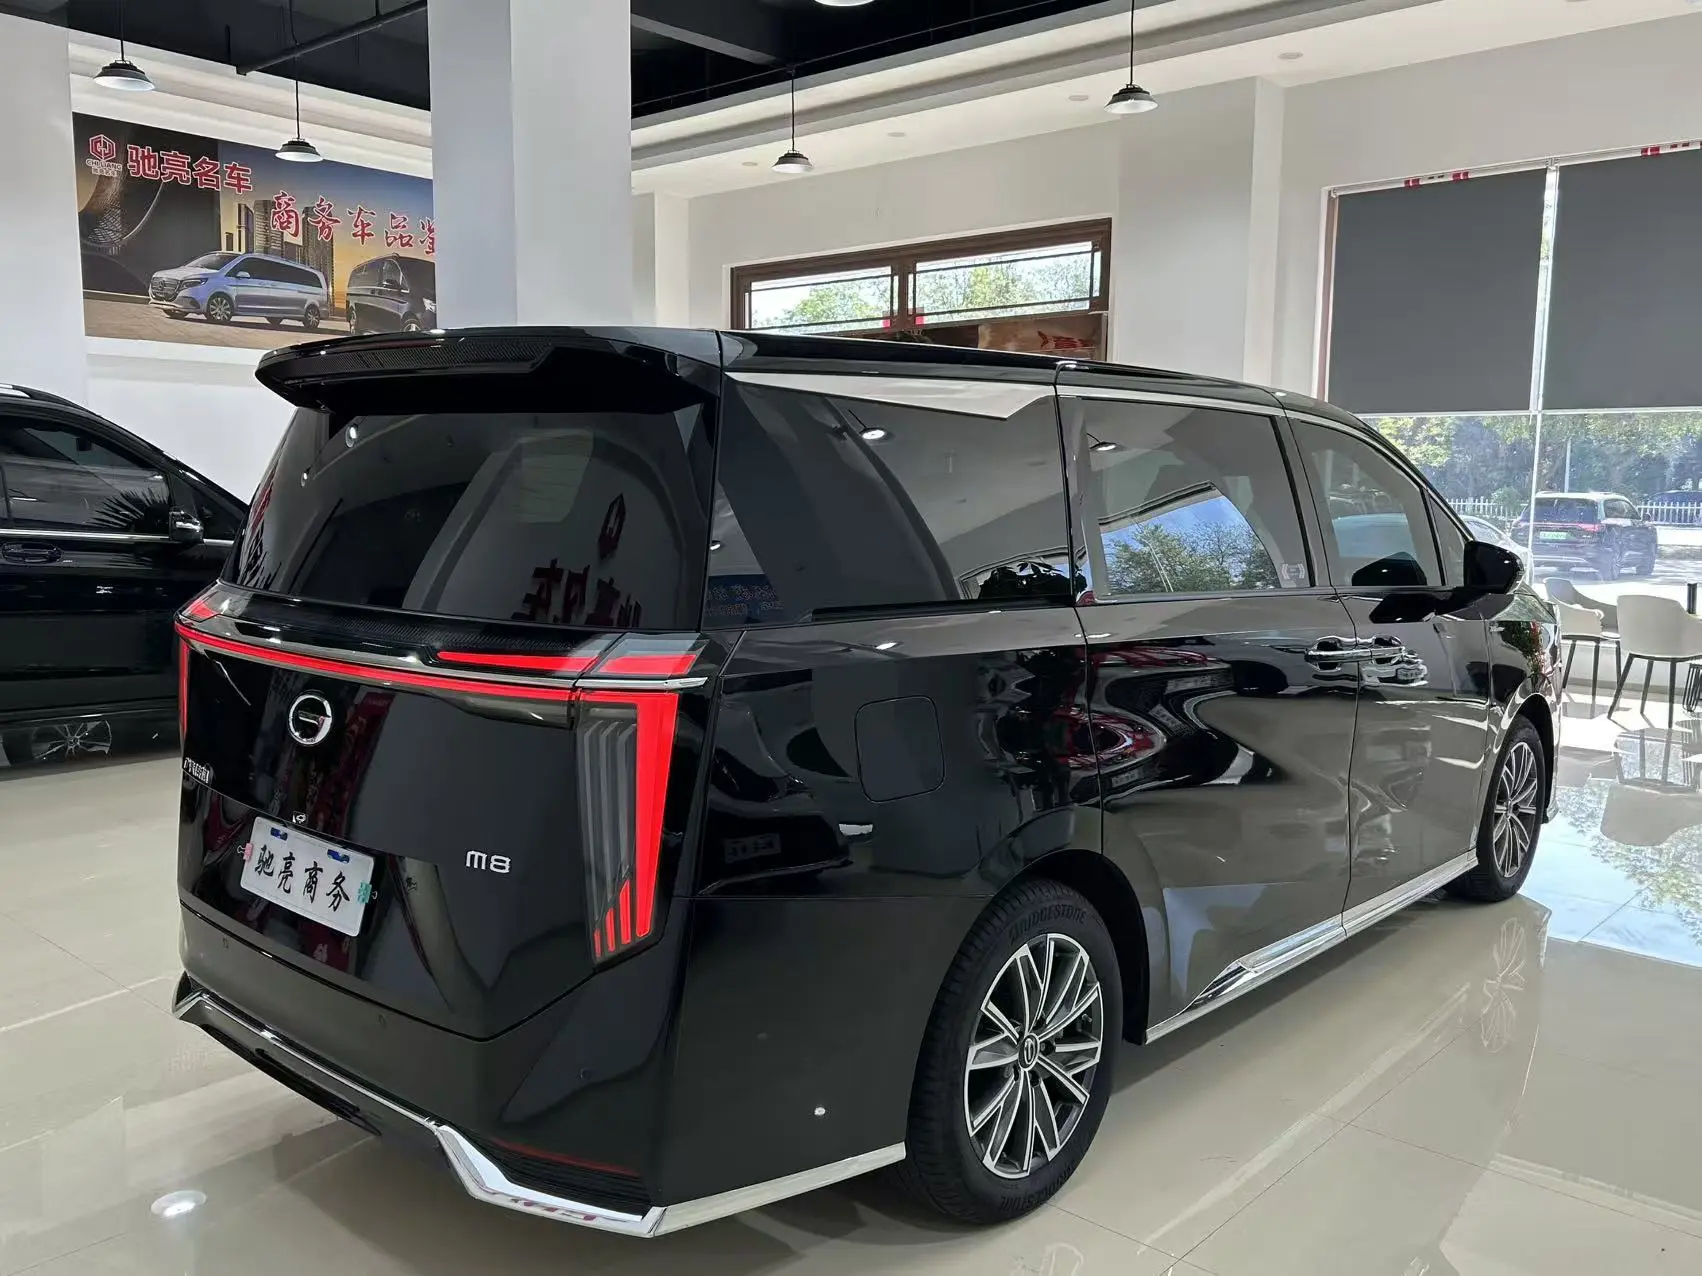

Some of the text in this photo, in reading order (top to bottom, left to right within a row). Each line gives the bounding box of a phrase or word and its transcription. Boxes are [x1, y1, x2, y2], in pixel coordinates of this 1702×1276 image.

[127, 145, 252, 194] 驰亮名车
[254, 846, 350, 912] 驰亮商务
[465, 851, 511, 874] M8
